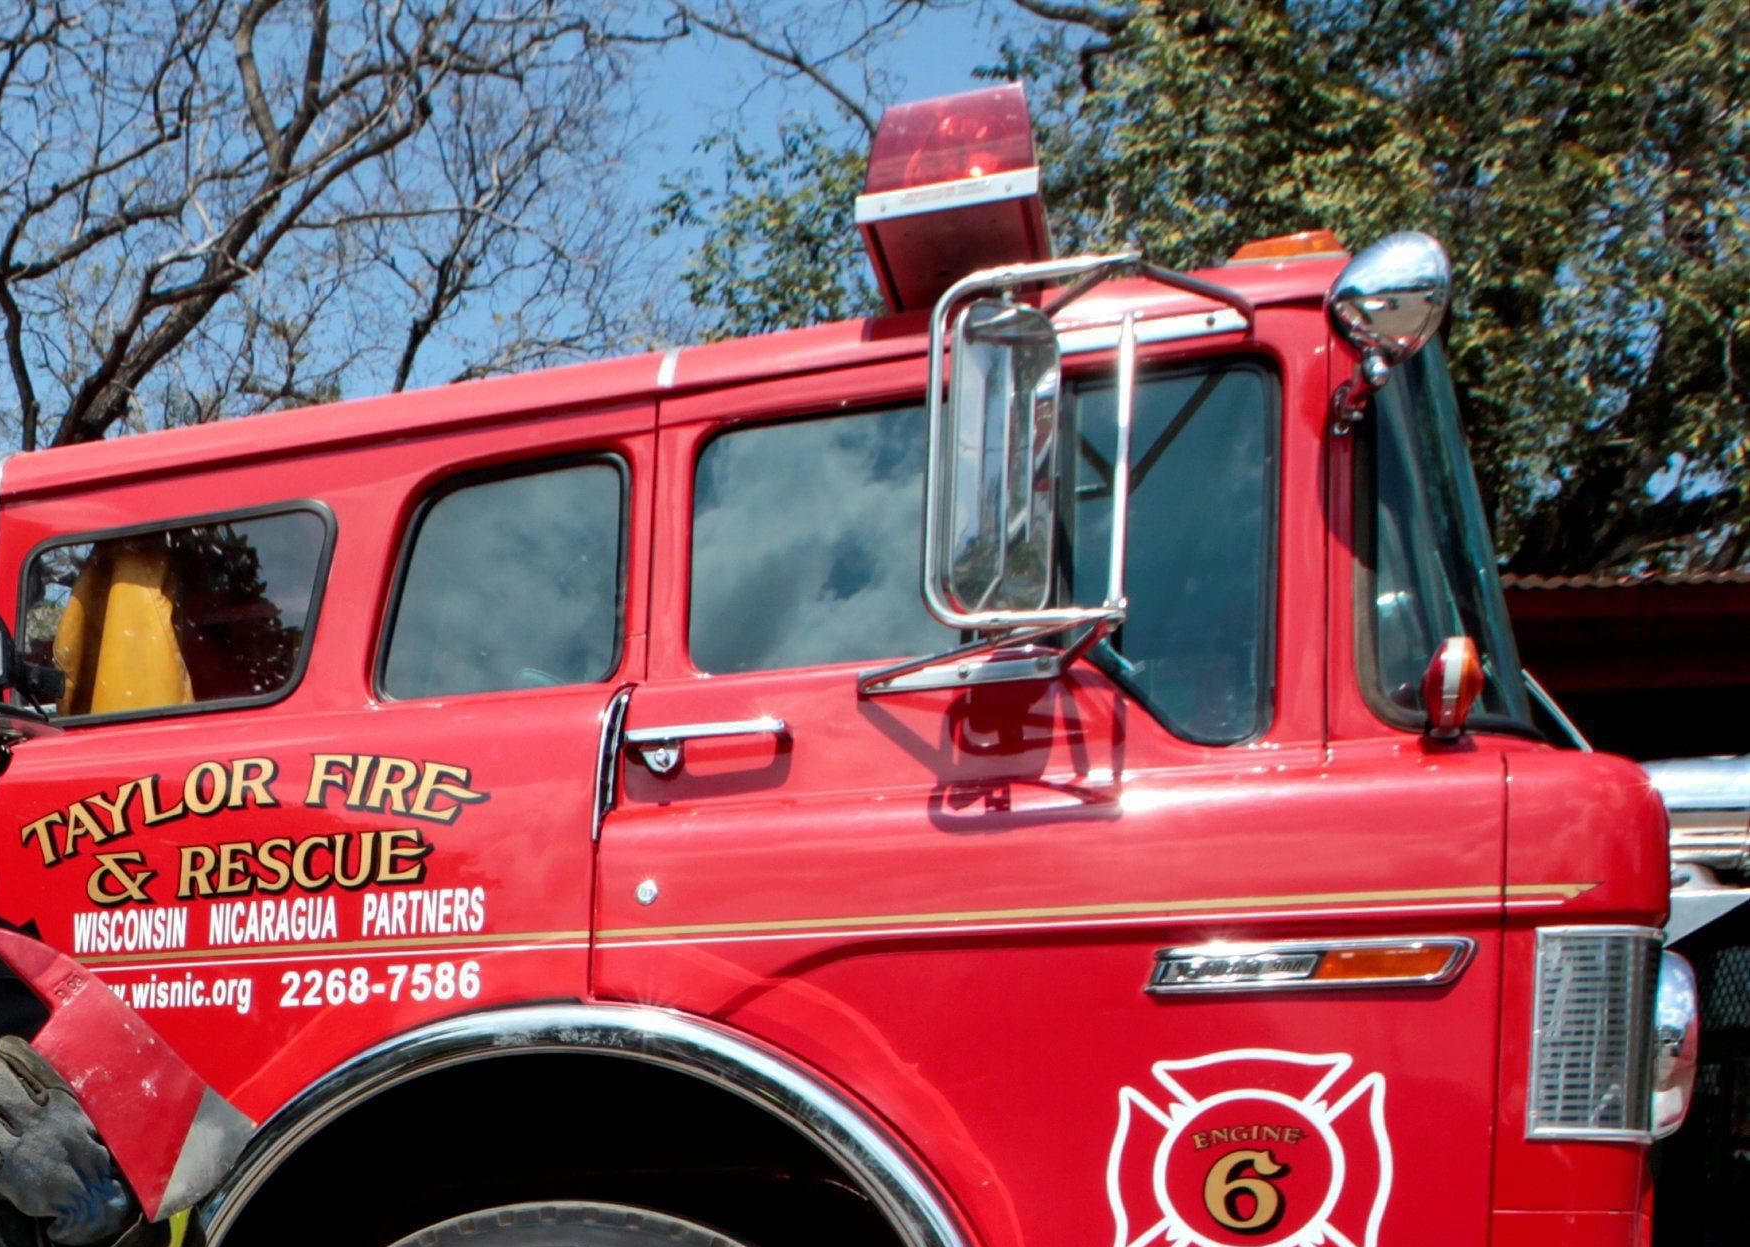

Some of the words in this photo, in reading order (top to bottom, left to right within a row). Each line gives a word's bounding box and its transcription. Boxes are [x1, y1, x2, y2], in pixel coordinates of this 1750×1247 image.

[22, 756, 277, 867] TAYLOR
[305, 753, 491, 825] FIRE
[87, 851, 157, 906] &
[177, 829, 433, 900] RESCUE
[73, 907, 188, 954] WISCONSIN
[209, 897, 338, 946] NICARAGUA
[361, 887, 485, 936] PARTNERS
[279, 960, 482, 1009] 2268-7586
[1191, 1123, 1306, 1152] ENGINE
[1203, 1147, 1293, 1237] 6
